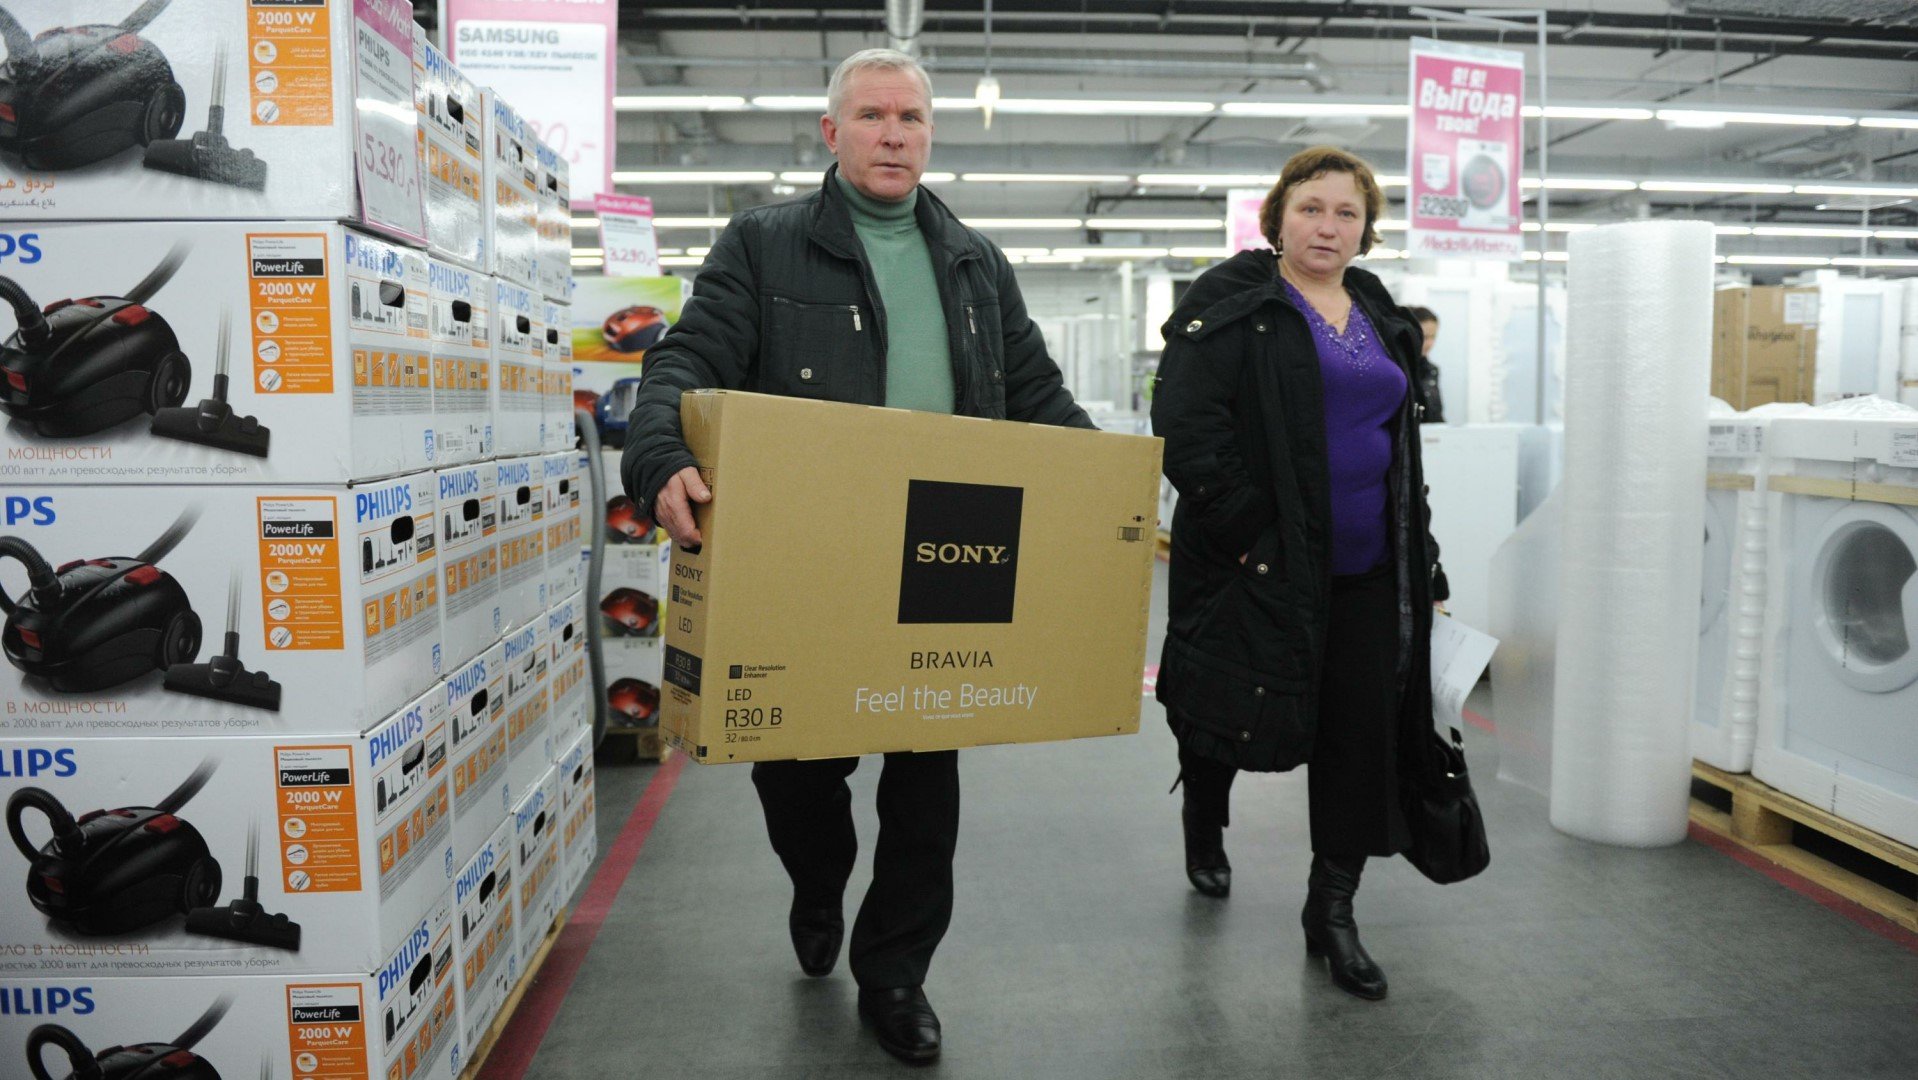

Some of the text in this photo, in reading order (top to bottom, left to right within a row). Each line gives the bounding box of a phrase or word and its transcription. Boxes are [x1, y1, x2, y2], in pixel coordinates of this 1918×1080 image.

[256, 11, 316, 26] 2000 W
[265, 25, 312, 33] ParquetCare
[458, 26, 559, 45] SAMSUNG
[358, 28, 390, 67] PHILIPS
[1451, 66, 1487, 89] Я! Я!
[1420, 78, 1517, 122] Выгода
[1436, 115, 1480, 135] твоя!
[364, 132, 415, 197] 5.390,-
[345, 234, 404, 278] PHILIPS
[255, 260, 305, 275] PowerLife
[258, 282, 317, 296] 2000 W
[429, 262, 470, 298] PHILIPS
[267, 296, 313, 304] ParquetCare
[497, 283, 530, 312] PHILIPS
[8, 446, 112, 461] МОЩНОСТИ
[0, 463, 247, 477] 000 ватт для превосходных результатов уборки
[498, 462, 530, 487] PHILIPS
[544, 457, 570, 479] PHILIPS
[439, 469, 479, 499] PHILIPS
[356, 483, 412, 523] PHILIPS
[265, 523, 314, 536] PowerLife
[268, 543, 326, 557] 2000 W
[916, 542, 1007, 564] SONY
[277, 557, 322, 565] ParquetCare
[675, 563, 704, 583] SONY
[549, 604, 573, 633] PHILIPS
[678, 616, 693, 635] LED
[505, 628, 534, 662] PHILIPS
[744, 664, 786, 673] Clear Resolution
[910, 650, 994, 670] BRAVIA
[447, 660, 487, 706] PHILIPS
[727, 688, 752, 702] LED
[855, 682, 1039, 713] Feel the Beauty
[7, 701, 127, 716] В МОЩНОСТИ
[725, 707, 782, 729] R30 B
[13, 719, 38, 729] 2000
[40, 720, 61, 728] ватт
[65, 720, 82, 729] для
[86, 719, 159, 730] превосходных
[161, 719, 221, 730] результатов
[223, 717, 259, 730] уборки
[369, 705, 423, 768] PHILIPS
[724, 732, 737, 744] 32
[282, 771, 331, 784] PowerLife
[286, 790, 343, 804] 2000 W
[295, 803, 339, 811] ParquetCare
[516, 789, 545, 834] PHILIPS
[456, 844, 494, 904] PHILIPS
[33, 944, 43, 956] В
[50, 943, 149, 957] МОЩНОСТИ
[40, 960, 64, 970] 2000
[66, 961, 88, 970] ватт
[90, 961, 108, 971] для
[111, 960, 181, 972] превосходных
[184, 959, 242, 971] результатов
[245, 957, 280, 970] уборки
[378, 920, 430, 1002] PHILIPS
[294, 1008, 341, 1020] PowerLife
[298, 1026, 353, 1040] 2000 W
[306, 1039, 349, 1047] ParquetCare
